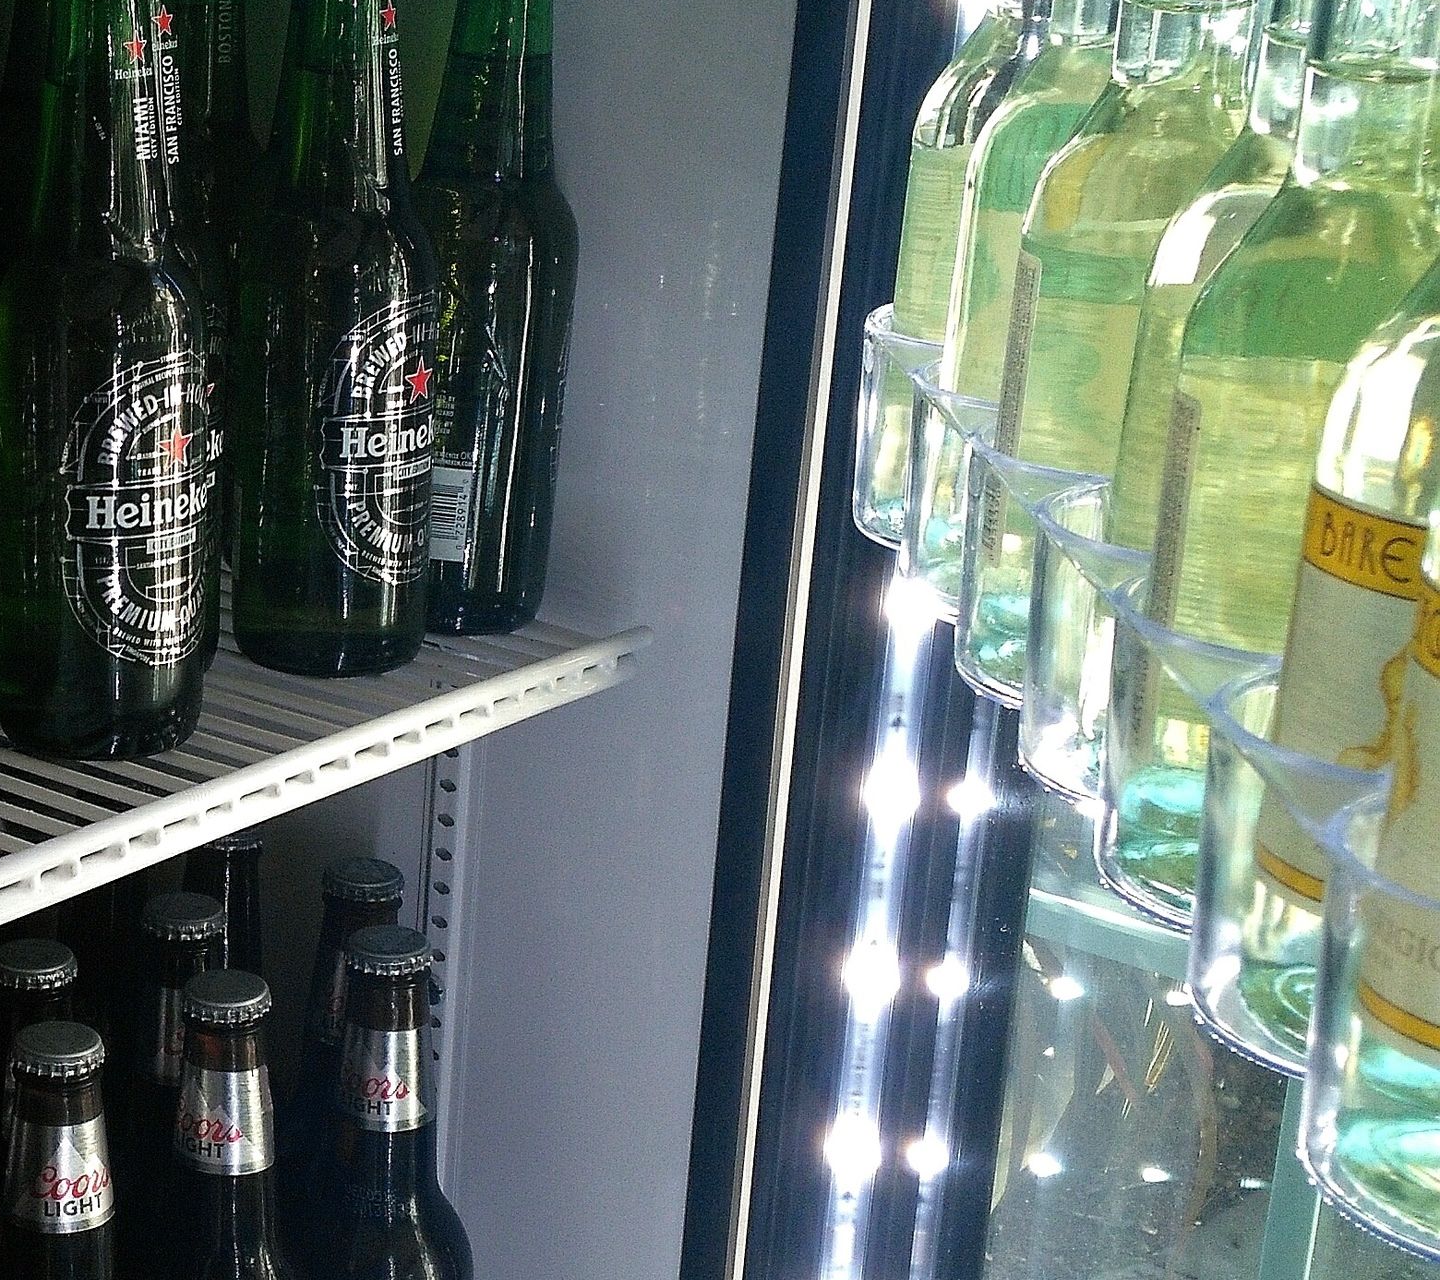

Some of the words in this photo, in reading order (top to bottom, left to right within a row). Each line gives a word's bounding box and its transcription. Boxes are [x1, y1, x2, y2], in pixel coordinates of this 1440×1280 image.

[162, 55, 178, 133] FRANCISCO
[388, 48, 403, 125] FRANCISCO
[132, 97, 151, 161] MIAMI
[167, 139, 180, 165] SAN
[392, 128, 404, 156] SAN
[351, 332, 407, 400] BREWED
[86, 483, 207, 530] Heineke
[348, 500, 413, 554] PREMIUM
[43, 1191, 105, 1217] LIGHT
